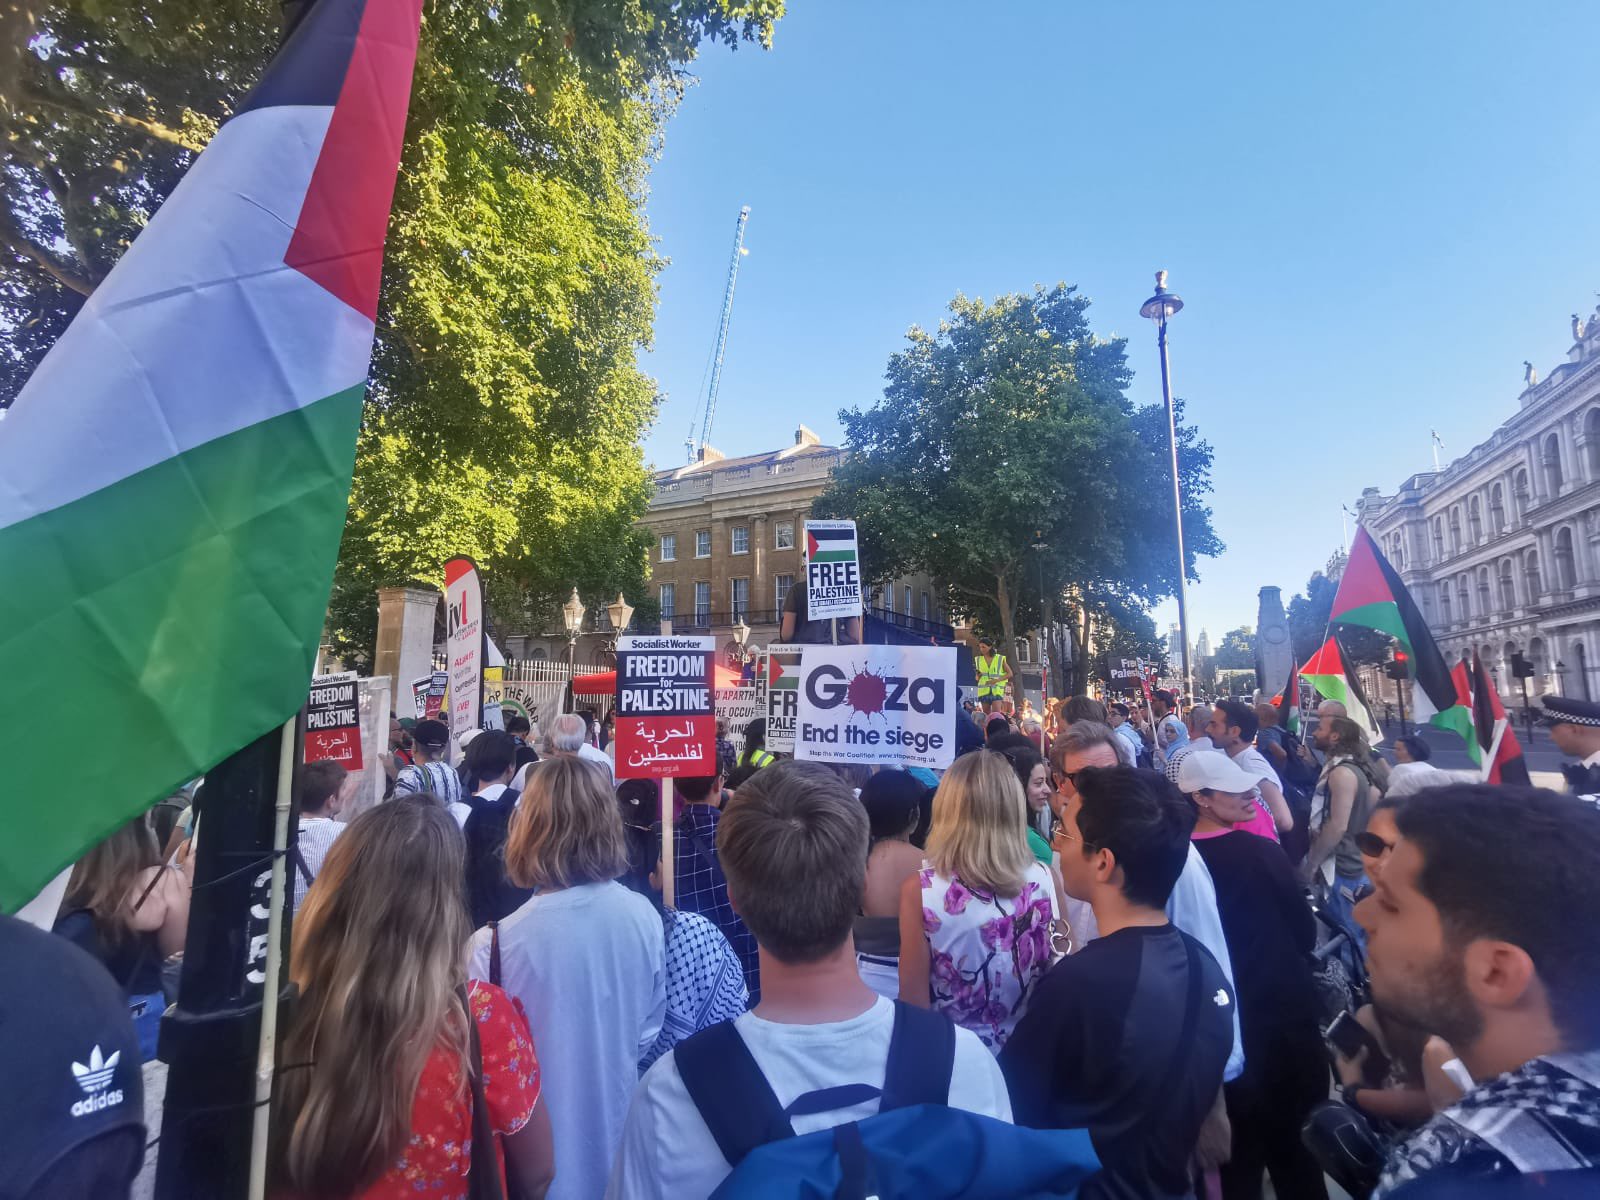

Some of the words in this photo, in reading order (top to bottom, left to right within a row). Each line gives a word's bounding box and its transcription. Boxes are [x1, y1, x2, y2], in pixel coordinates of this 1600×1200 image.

[809, 562, 858, 588] FREE
[810, 586, 859, 599] PALESTINE
[632, 639, 670, 649] Socialist
[670, 639, 701, 649] Worker
[626, 655, 705, 677] FREEDOM
[660, 677, 674, 688] for
[805, 664, 945, 714] Gza
[310, 685, 353, 705] FREEDOM
[415, 695, 426, 706] FR
[621, 688, 710, 711] PALESTINE
[723, 690, 755, 701] APARTH
[755, 696, 766, 704] PAL
[769, 690, 798, 716] FR
[488, 690, 501, 704] OP
[504, 687, 523, 701] THE
[523, 694, 539, 725] WAR
[715, 707, 727, 717] HE
[308, 708, 356, 729] PALESTINE
[768, 717, 797, 730] PALE
[316, 732, 348, 749] الحرية
[636, 720, 694, 744] الحرية
[802, 723, 838, 743] End
[844, 724, 881, 745] the
[885, 726, 944, 754] siege
[628, 743, 703, 767] لفلسطين
[809, 750, 822, 758] Stop
[846, 751, 875, 759] Coalition
[70, 1089, 123, 1117] adidas
